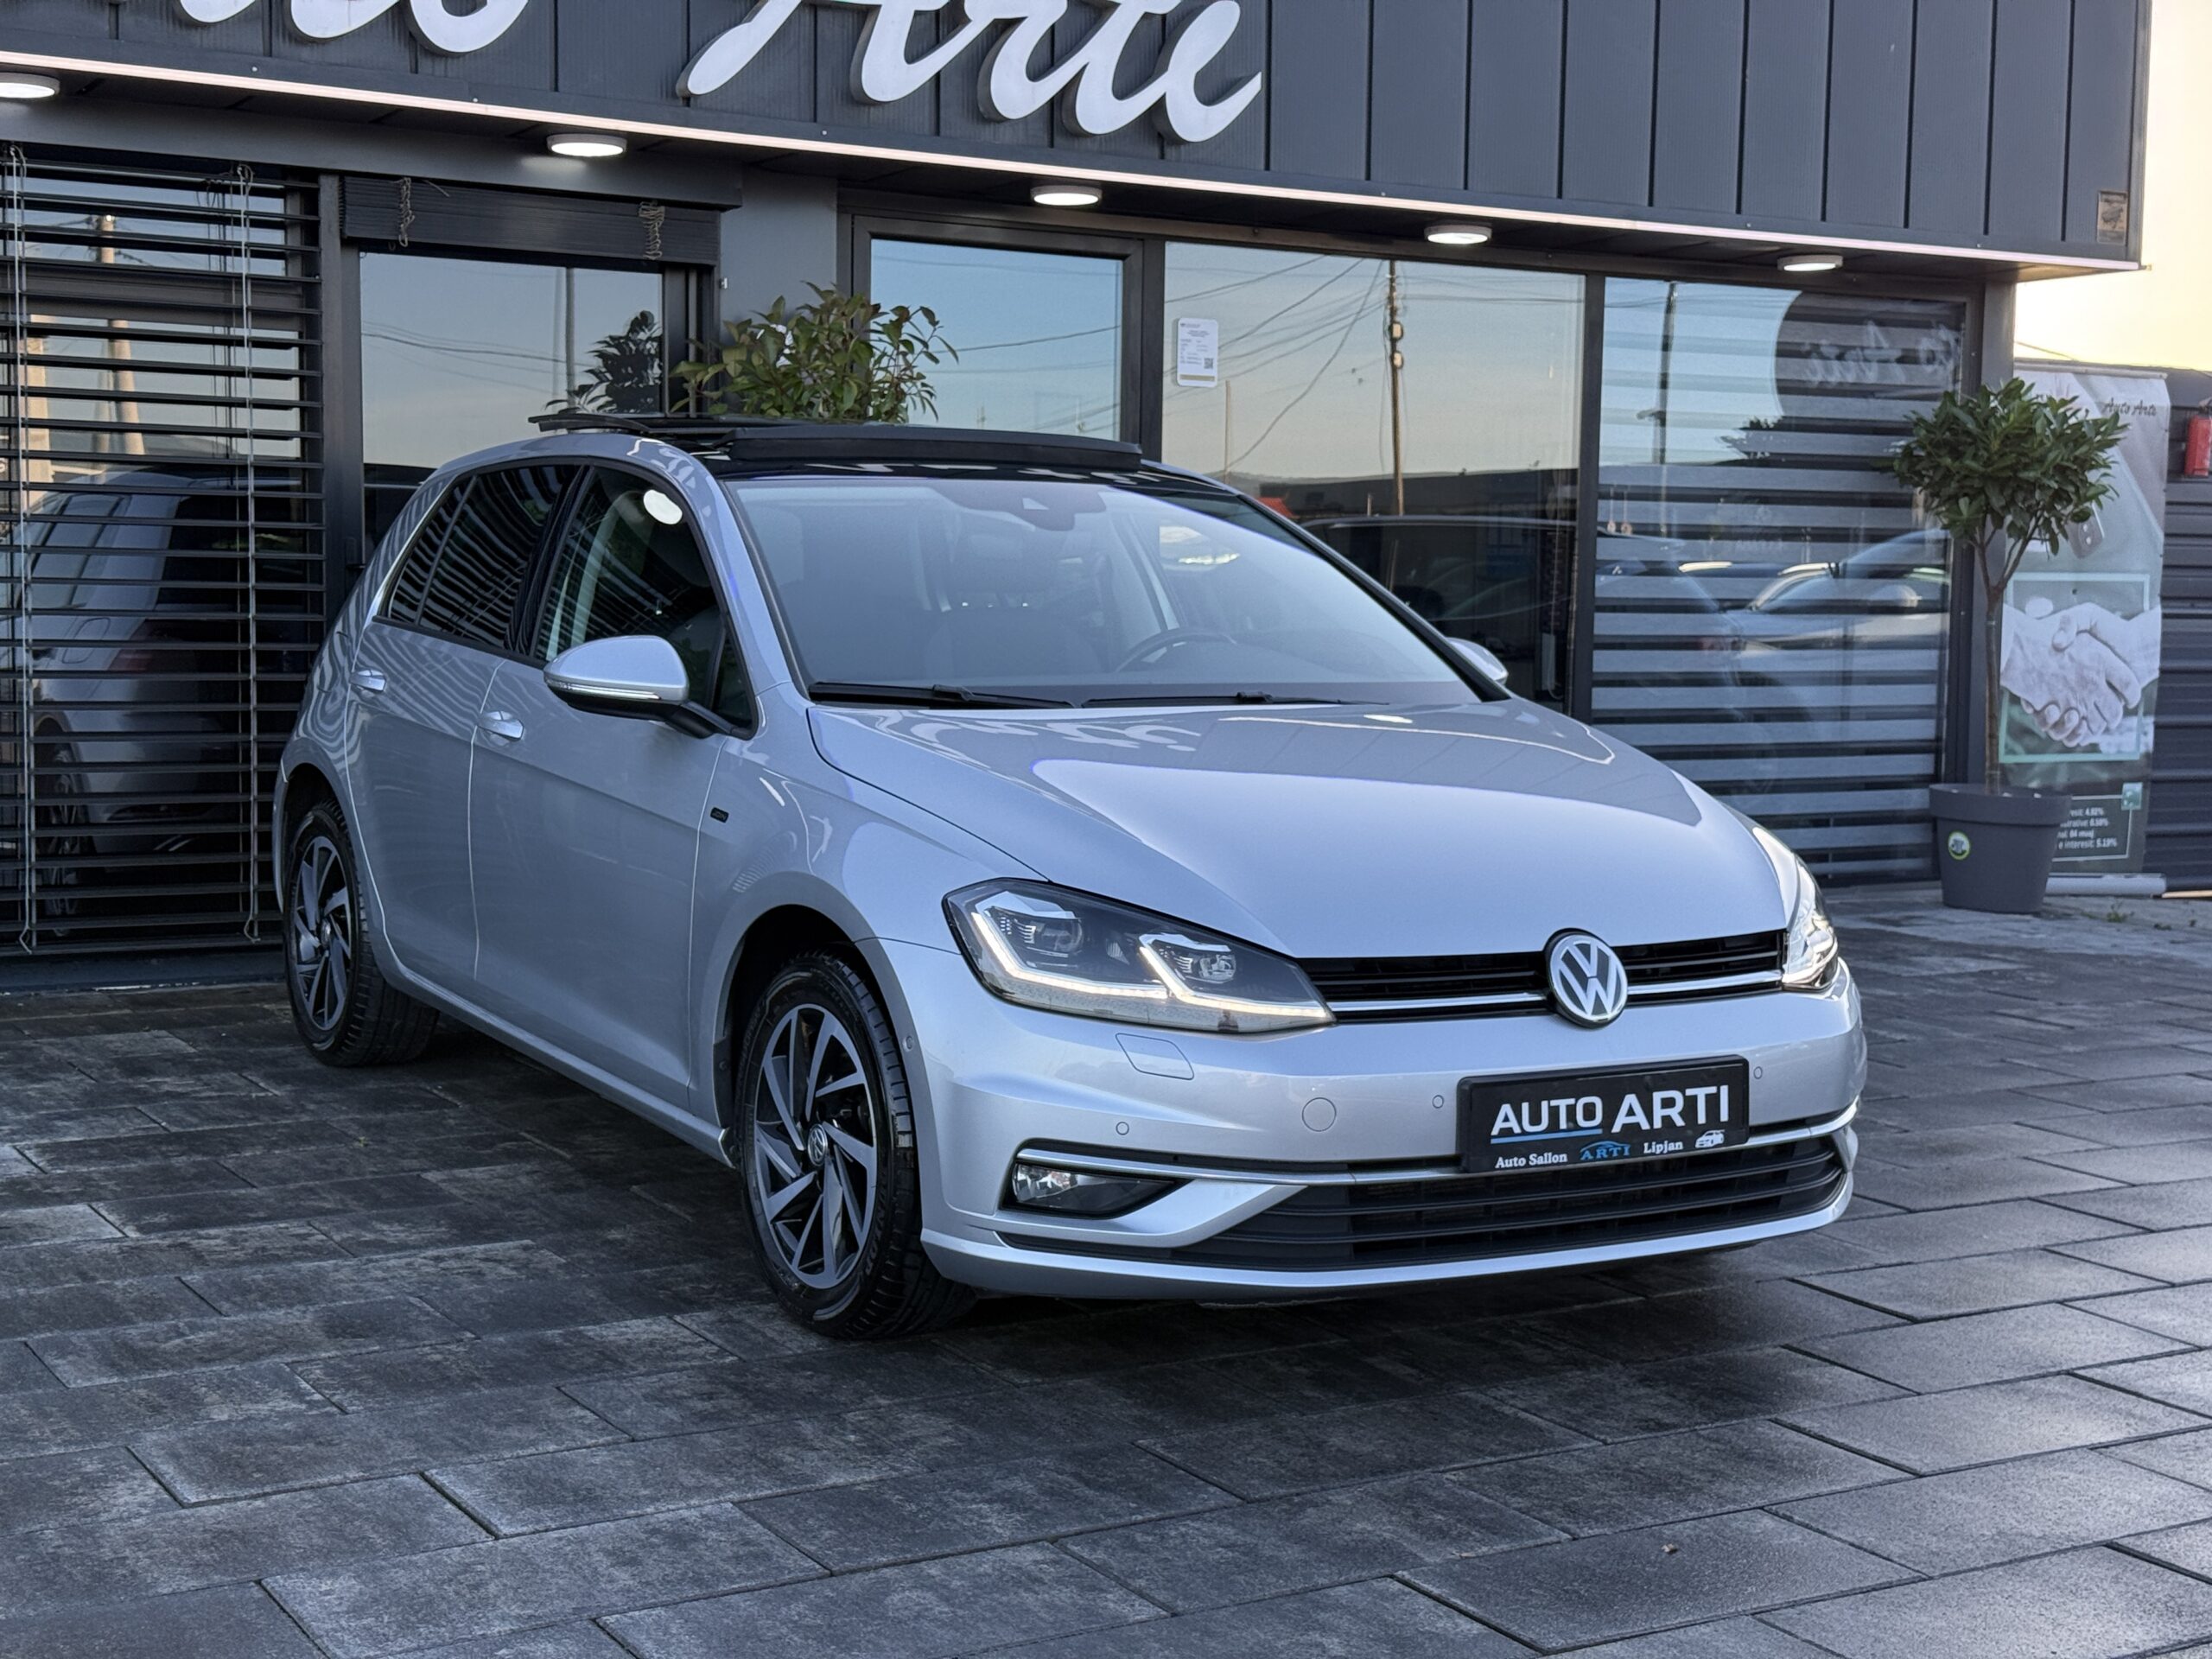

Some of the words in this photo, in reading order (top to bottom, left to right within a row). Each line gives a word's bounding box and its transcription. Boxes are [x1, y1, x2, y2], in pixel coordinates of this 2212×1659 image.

[1550, 935, 1628, 1021] VW
[1491, 1096, 1604, 1136] AUTO
[1611, 1084, 1729, 1134] ARTI
[1495, 1156, 1526, 1169] Auto
[1580, 1146, 1630, 1160] ARTI
[1643, 1140, 1684, 1154] Lipjan
